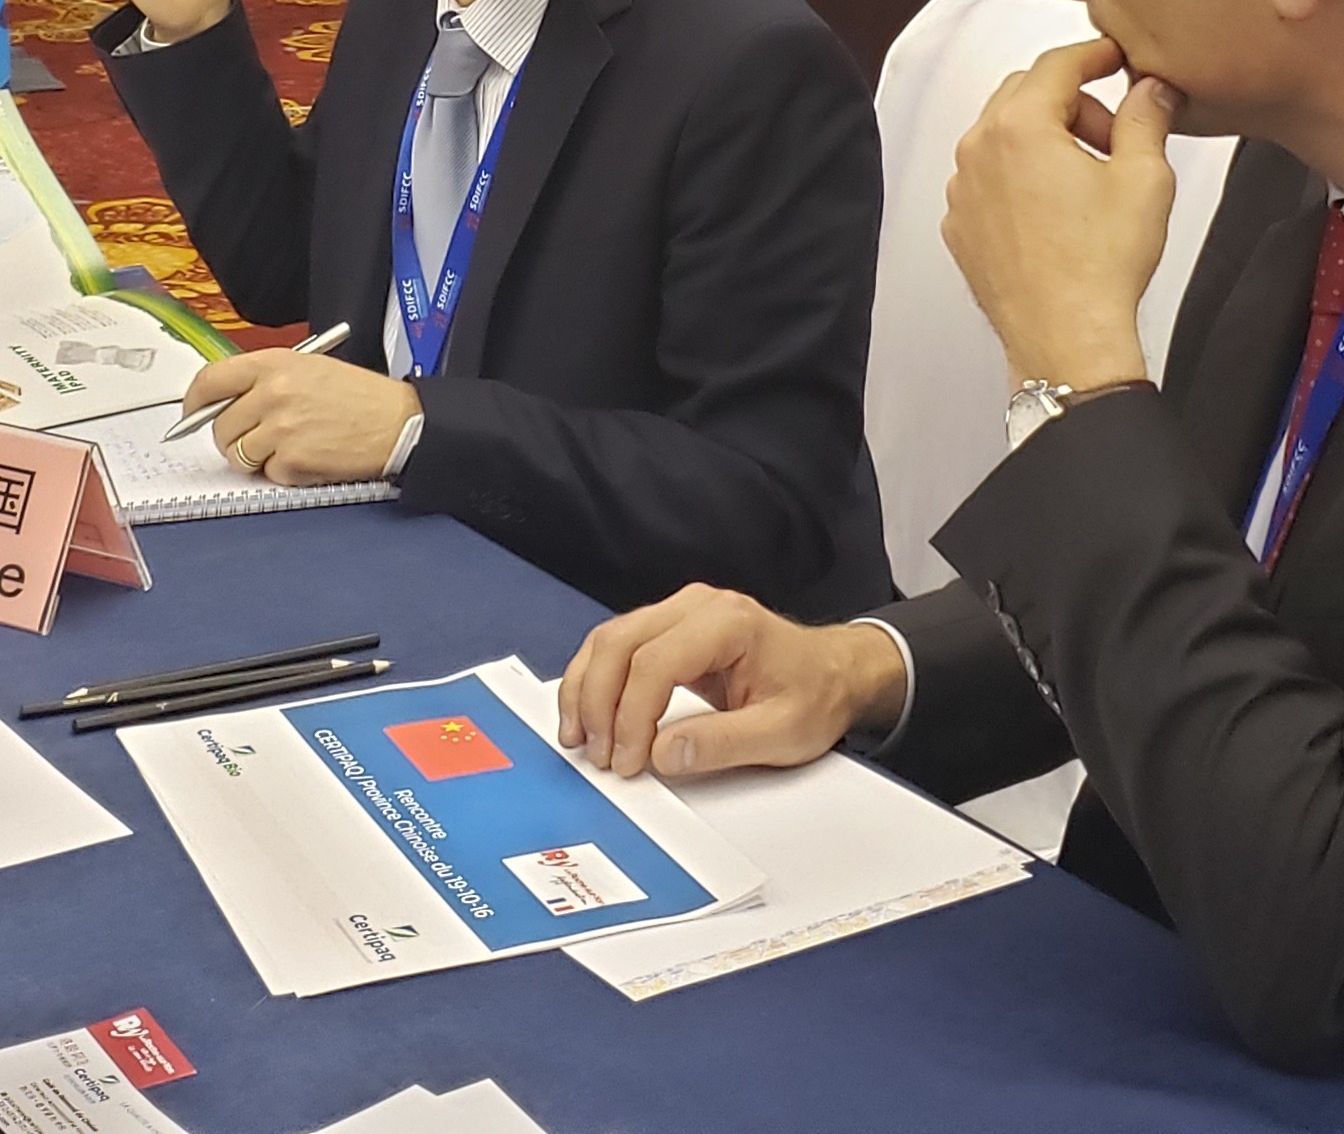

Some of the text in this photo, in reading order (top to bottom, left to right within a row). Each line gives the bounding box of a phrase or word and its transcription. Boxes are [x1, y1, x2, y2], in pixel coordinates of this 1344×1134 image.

[399, 172, 412, 213] SDIFCC
[469, 170, 489, 211] SDIFCC
[402, 279, 419, 321] SDIFCC
[436, 269, 455, 310] SDIFCC
[8, 345, 69, 391] MATERNITY
[58, 370, 83, 387] PAD
[197, 729, 242, 777] Certipaq Bio
[314, 729, 365, 778] CERTIPAQ
[360, 780, 402, 822] Province
[394, 819, 440, 864] Chinoise
[431, 861, 454, 879] du
[444, 875, 495, 919] 19-10-16
[393, 789, 448, 840] Rencontre
[349, 914, 396, 962] Certipaq
[74, 1068, 110, 1103] Certipaq
